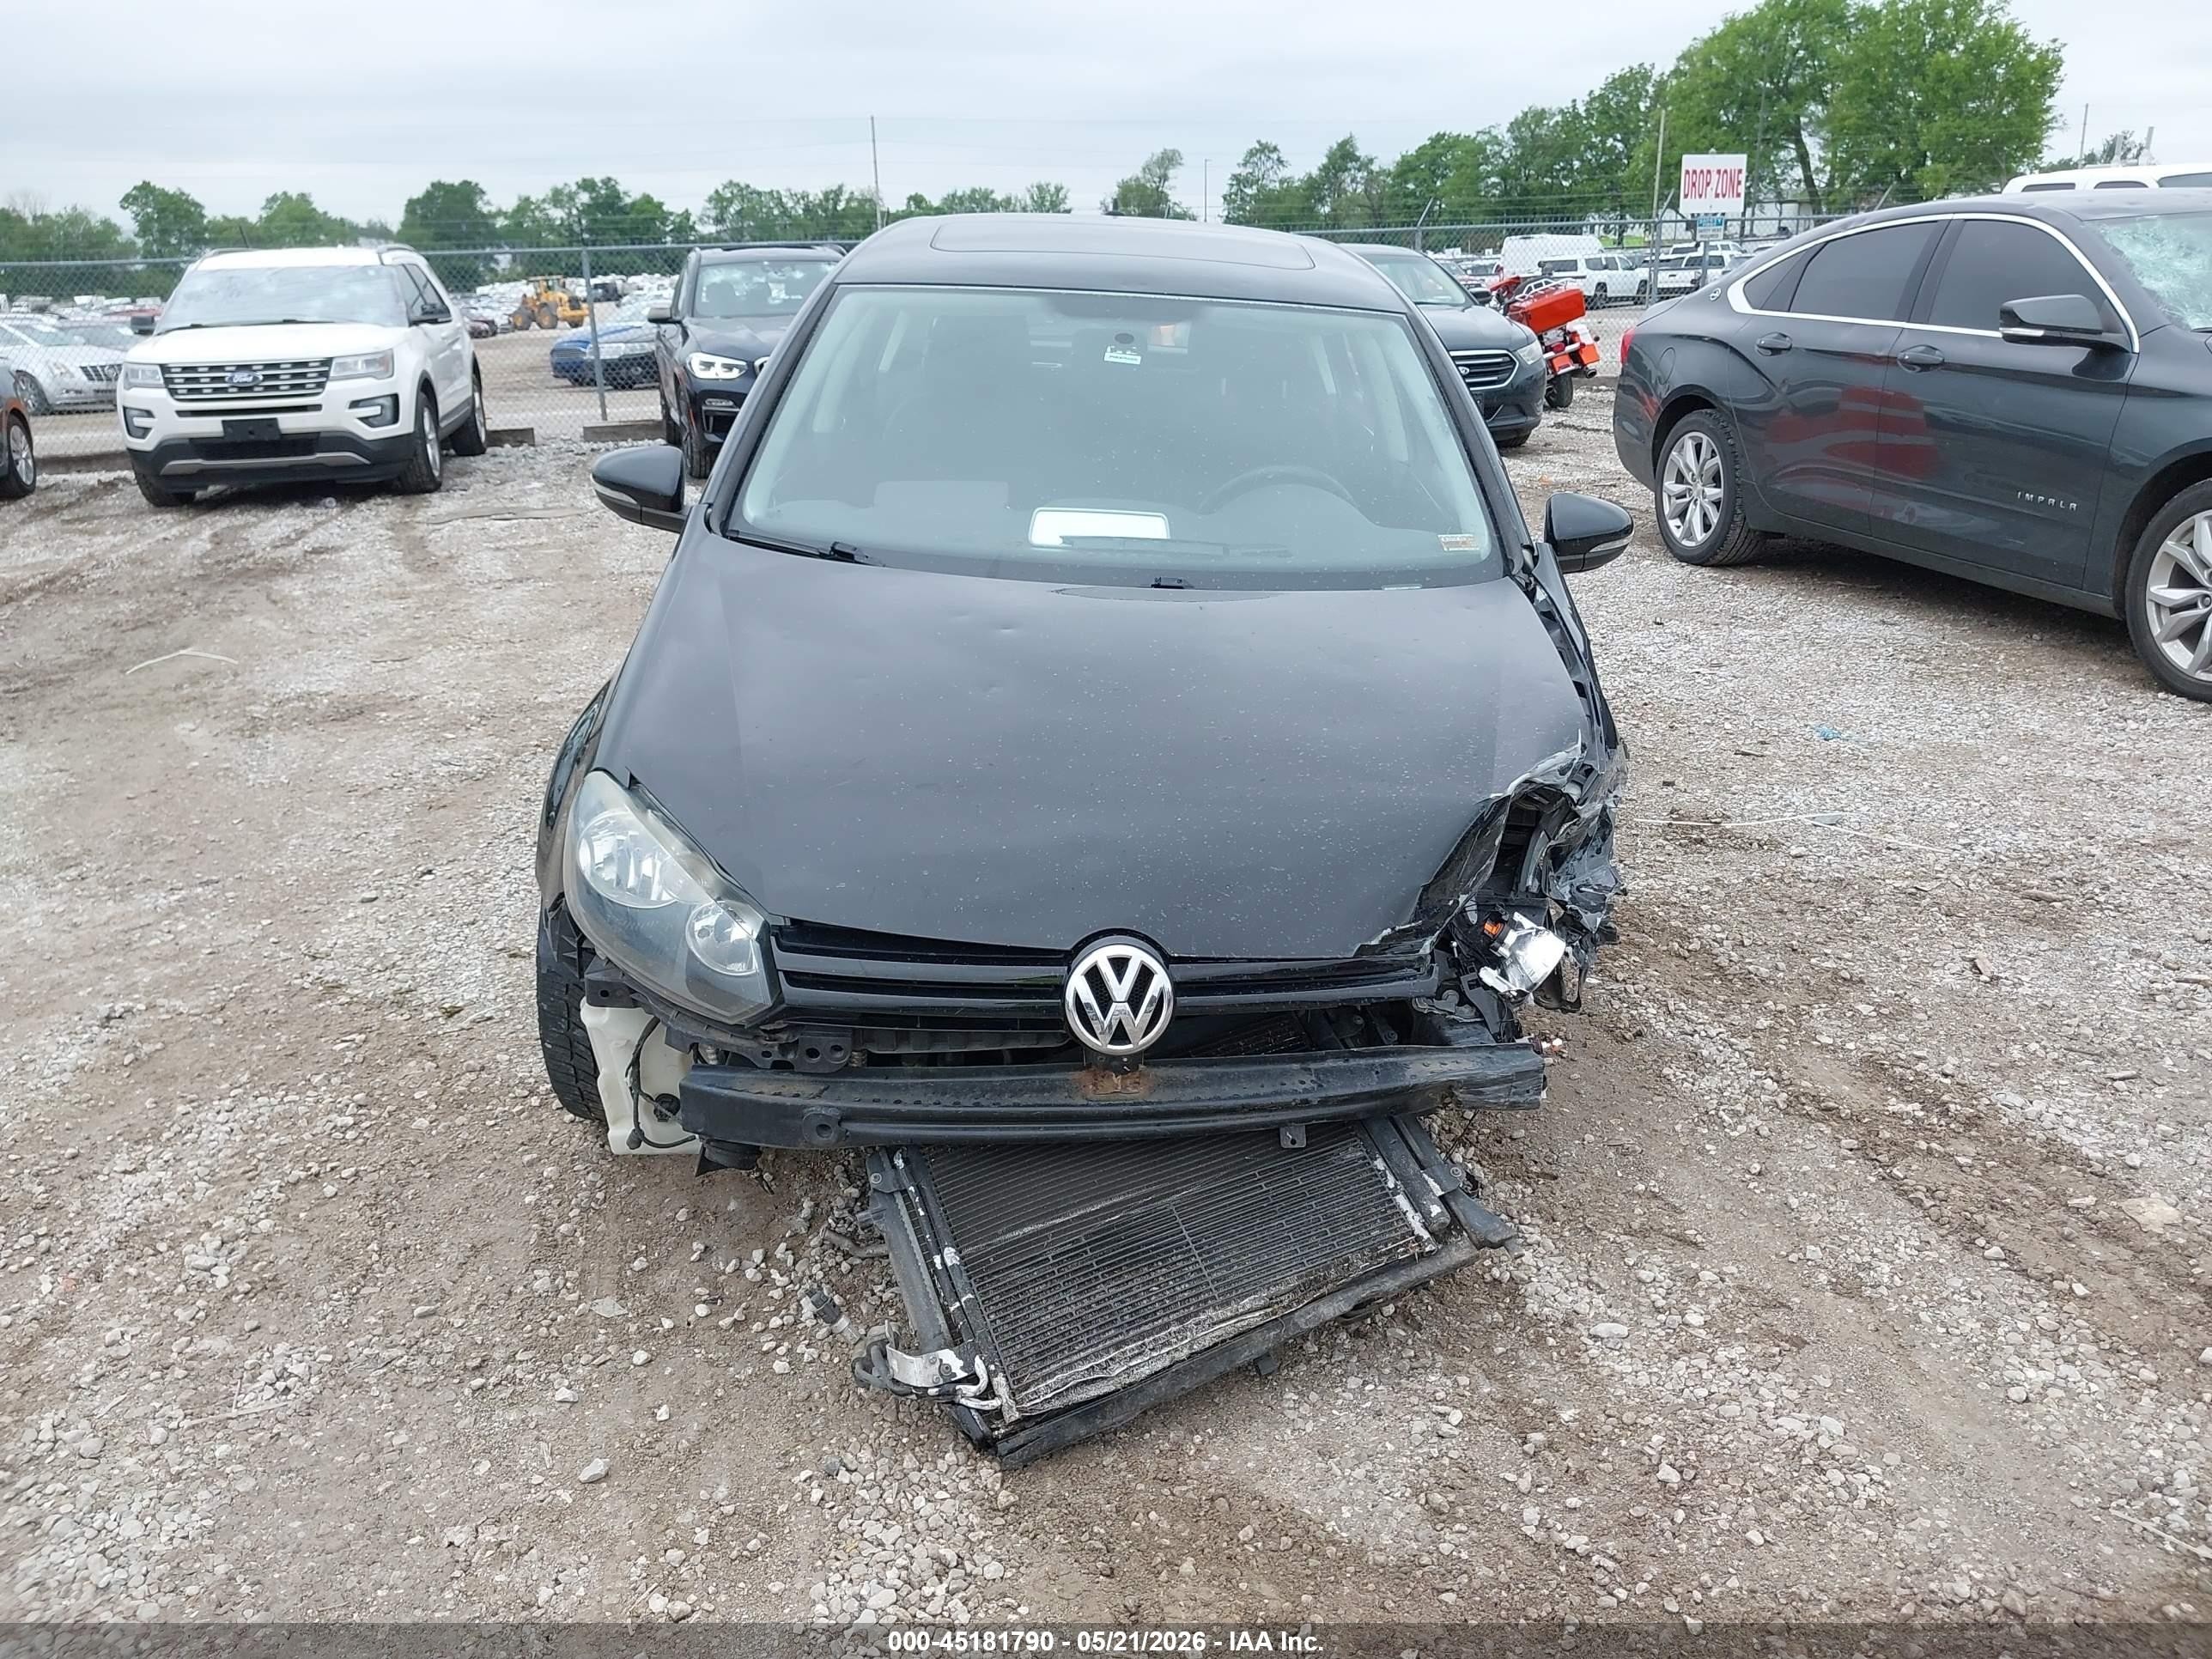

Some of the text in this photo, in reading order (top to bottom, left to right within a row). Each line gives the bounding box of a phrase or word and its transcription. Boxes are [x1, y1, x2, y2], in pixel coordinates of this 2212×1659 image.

[1683, 168, 1742, 199] DROP ZONE
[2017, 490, 2077, 512] IMPALA
[1067, 947, 1172, 1052] VW
